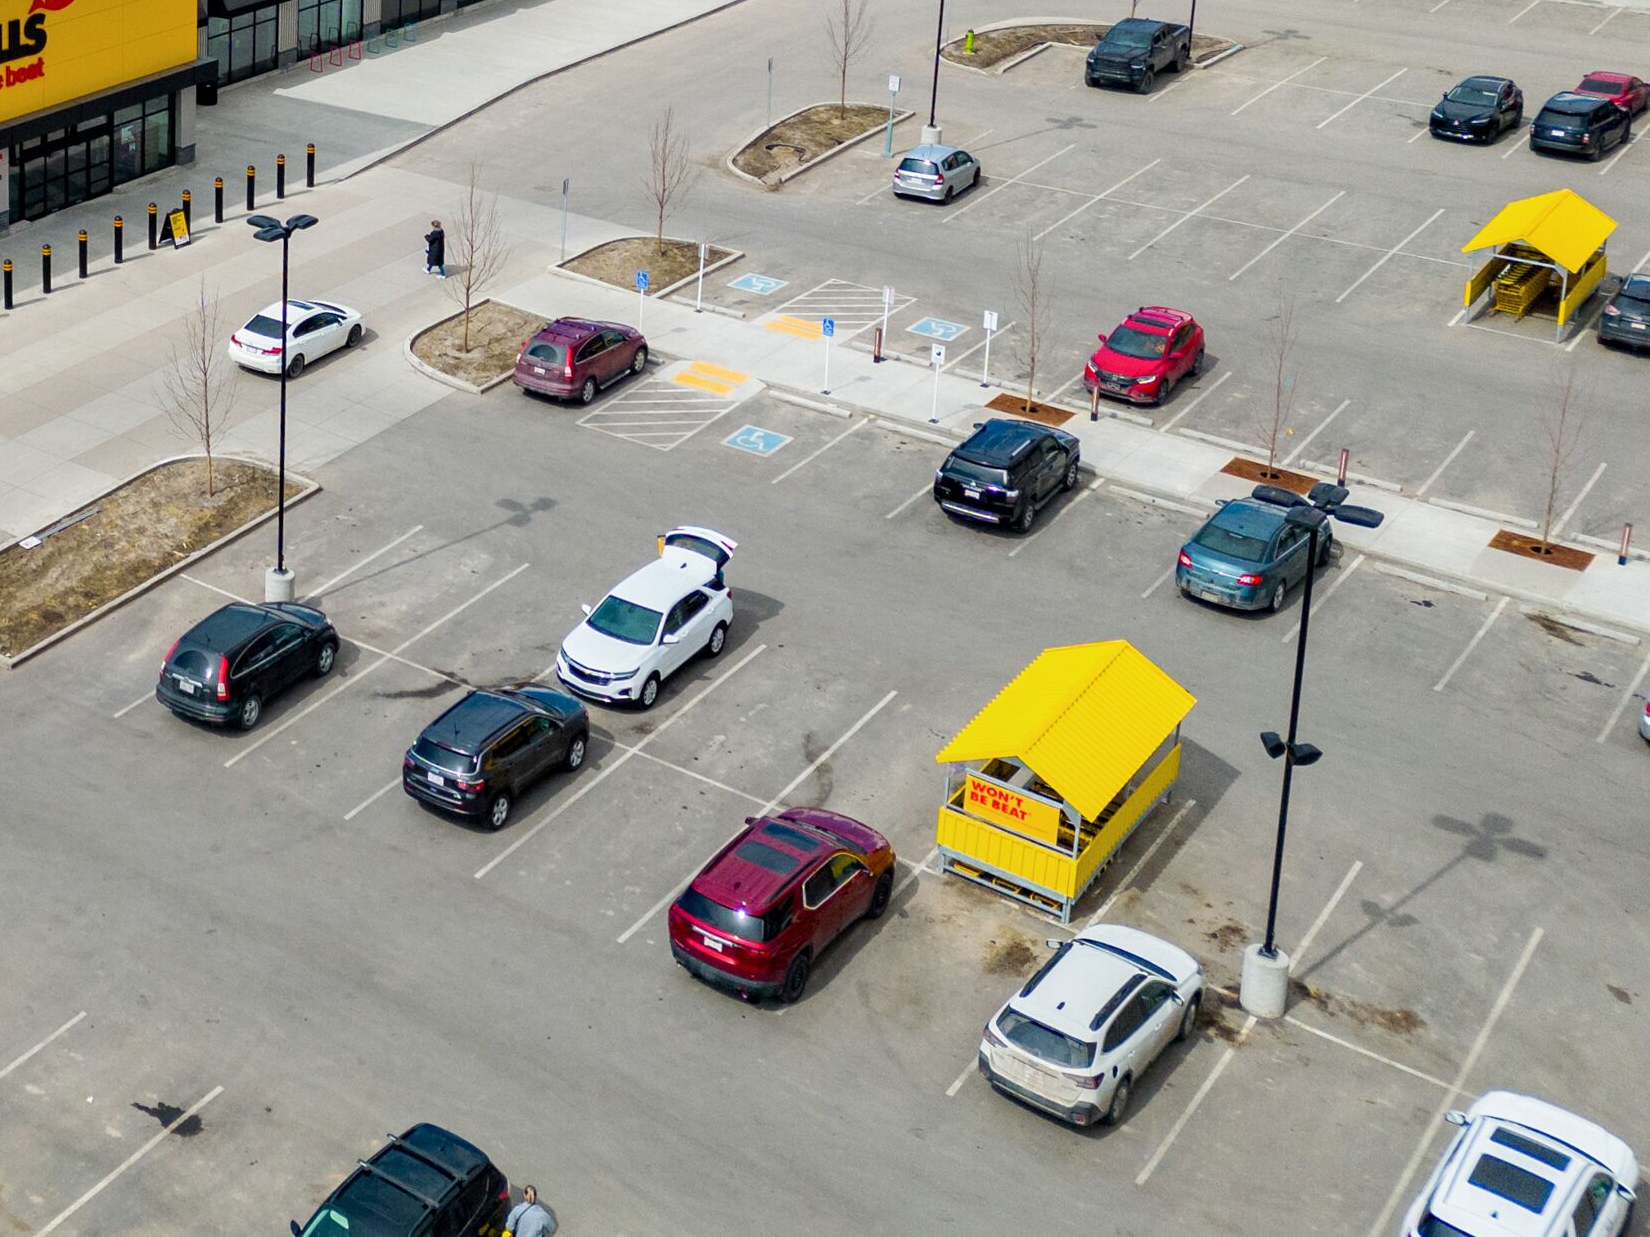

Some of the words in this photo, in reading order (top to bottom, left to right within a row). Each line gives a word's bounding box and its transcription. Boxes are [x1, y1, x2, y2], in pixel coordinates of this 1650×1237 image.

[5, 57, 45, 87] beat
[970, 791, 988, 806] BE
[992, 799, 1028, 821] BEAT
[971, 780, 1023, 808] WON'T
